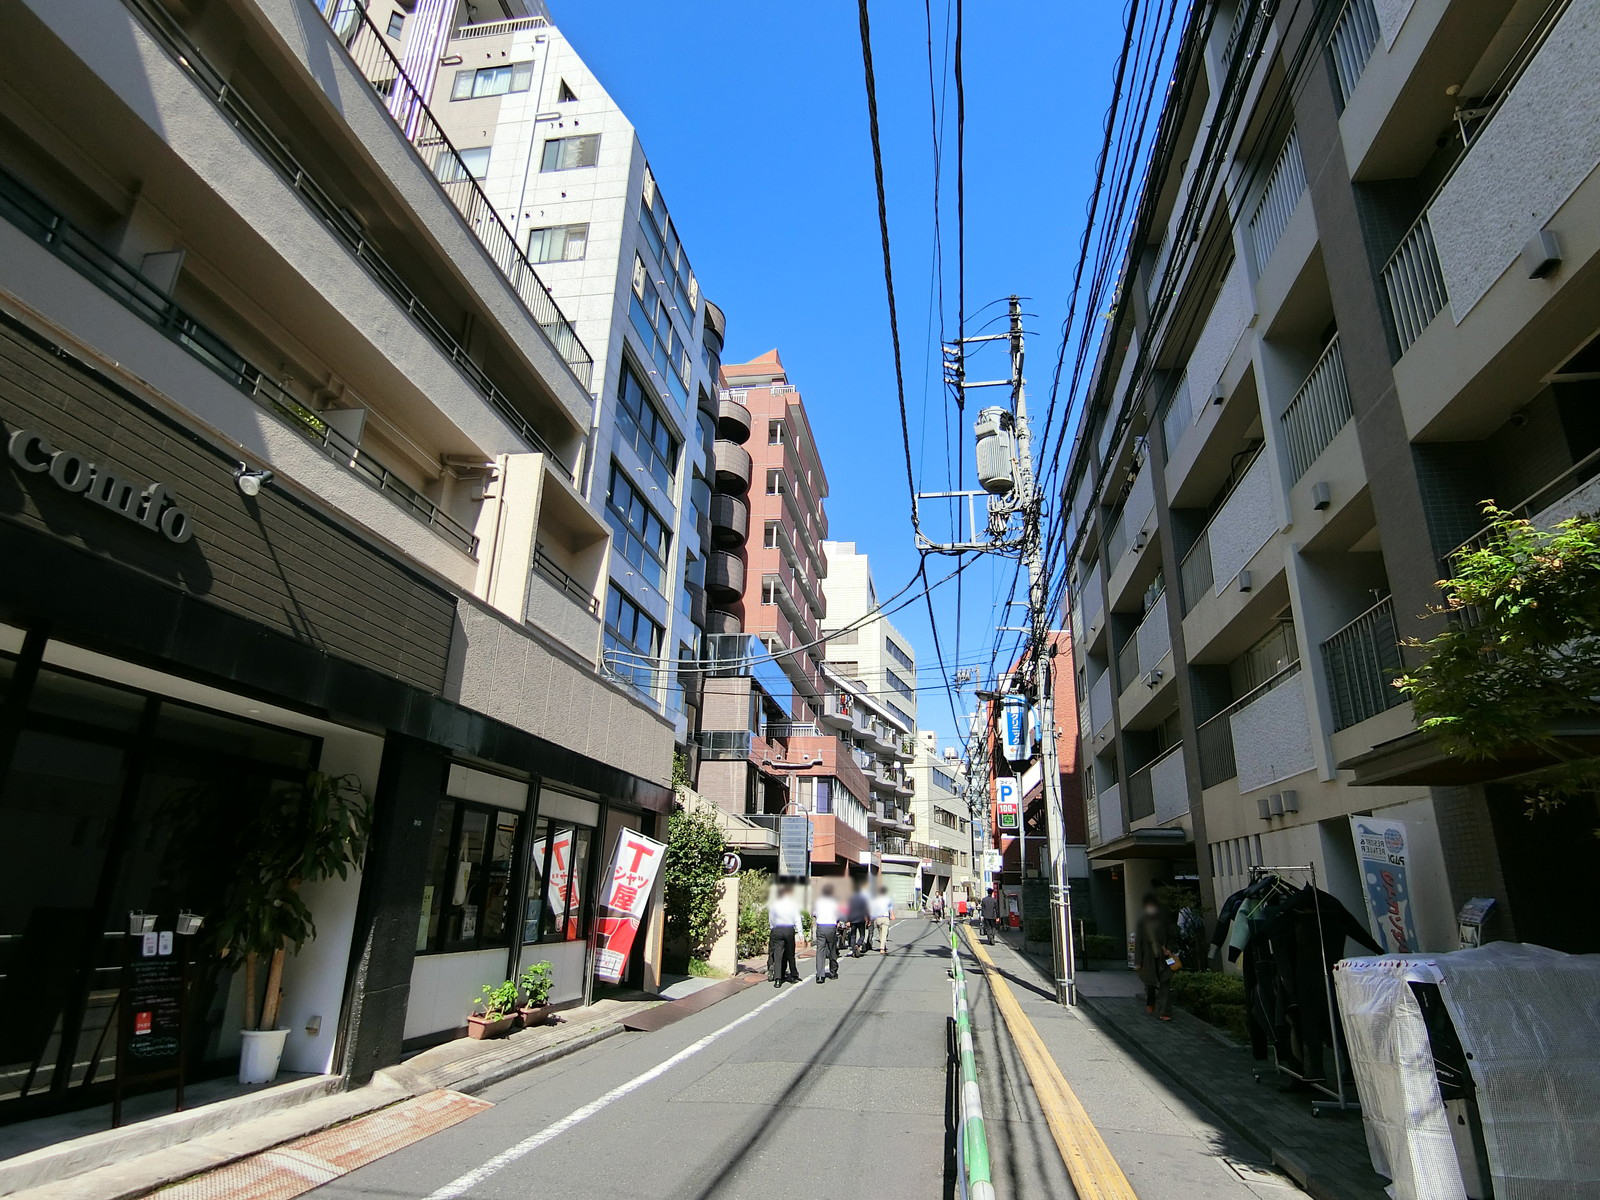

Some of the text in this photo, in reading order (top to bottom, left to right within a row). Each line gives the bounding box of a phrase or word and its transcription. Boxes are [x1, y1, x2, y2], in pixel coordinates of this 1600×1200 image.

[8, 429, 194, 544] comfo
[1010, 706, 1021, 745] クリニック
[1000, 785, 1013, 802] P
[613, 865, 649, 888] シャツ
[608, 882, 639, 913] 屋
